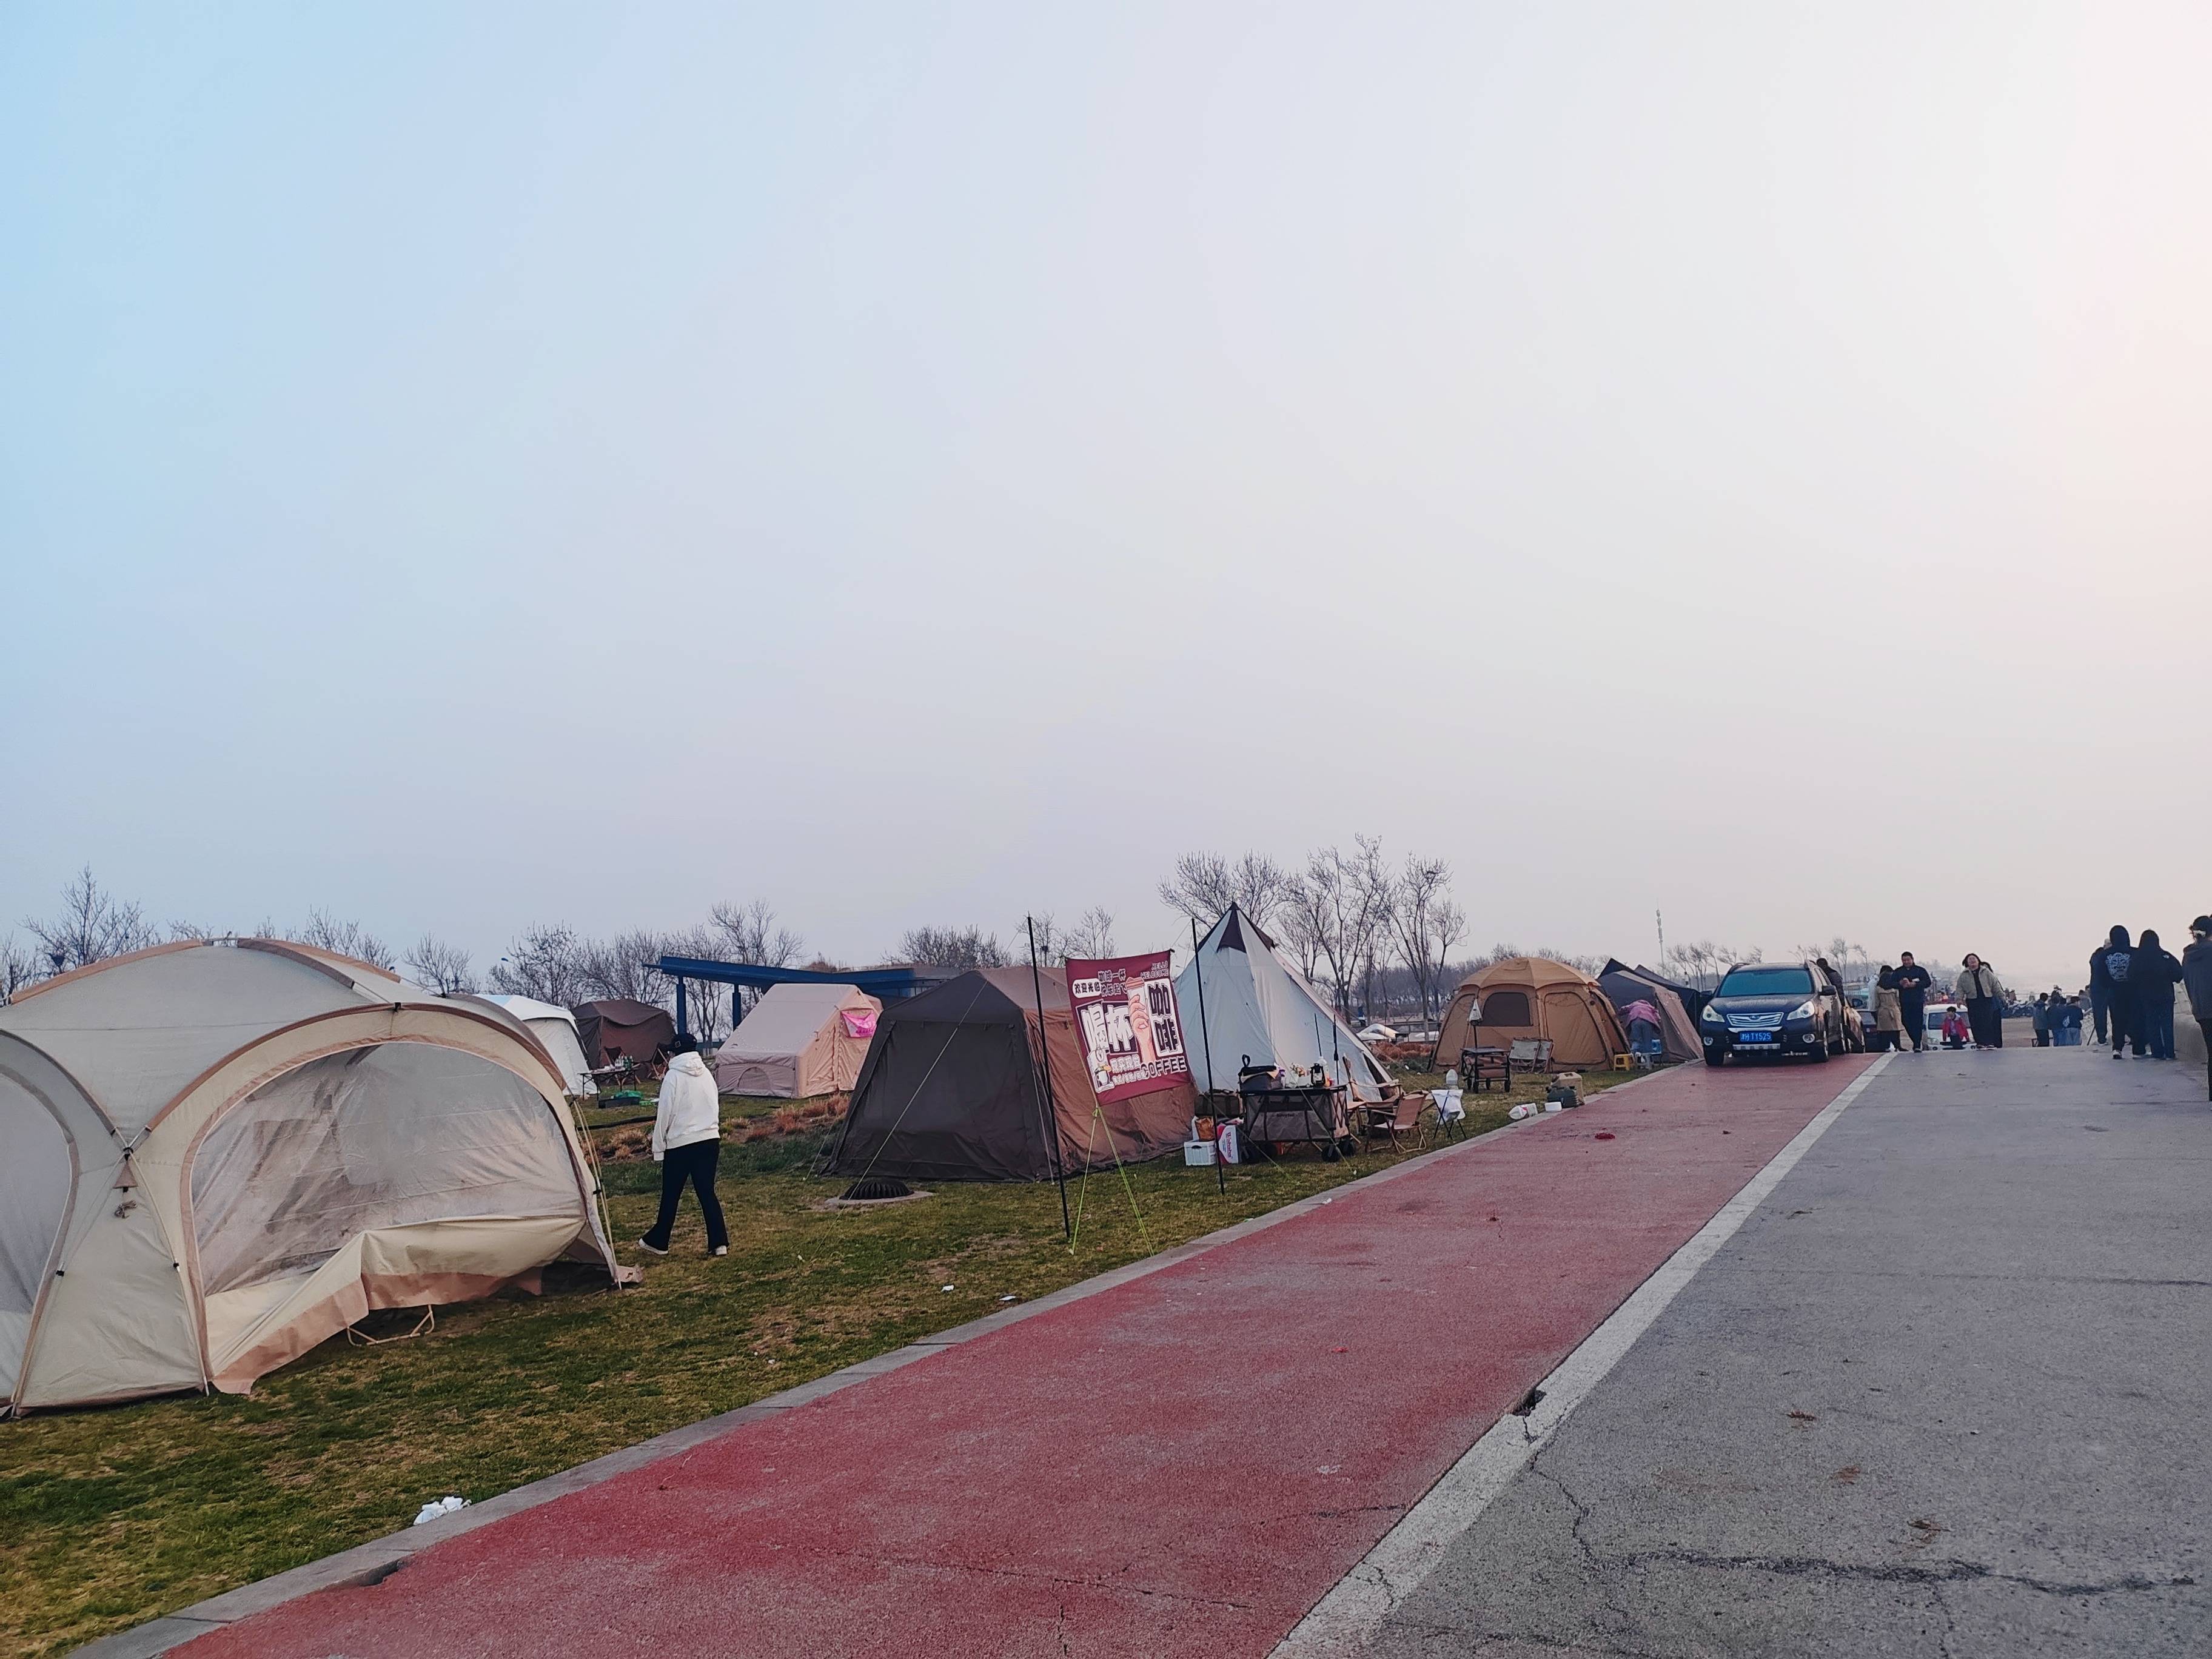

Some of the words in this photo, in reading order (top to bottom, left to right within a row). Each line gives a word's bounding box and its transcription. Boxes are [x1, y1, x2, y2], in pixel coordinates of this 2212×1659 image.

[1074, 981, 1101, 994] 欢迎光临
[1081, 1003, 1134, 1052] 喝杯
[1148, 983, 1179, 1053] 咖啡
[1141, 1056, 1187, 1079] COFFEE
